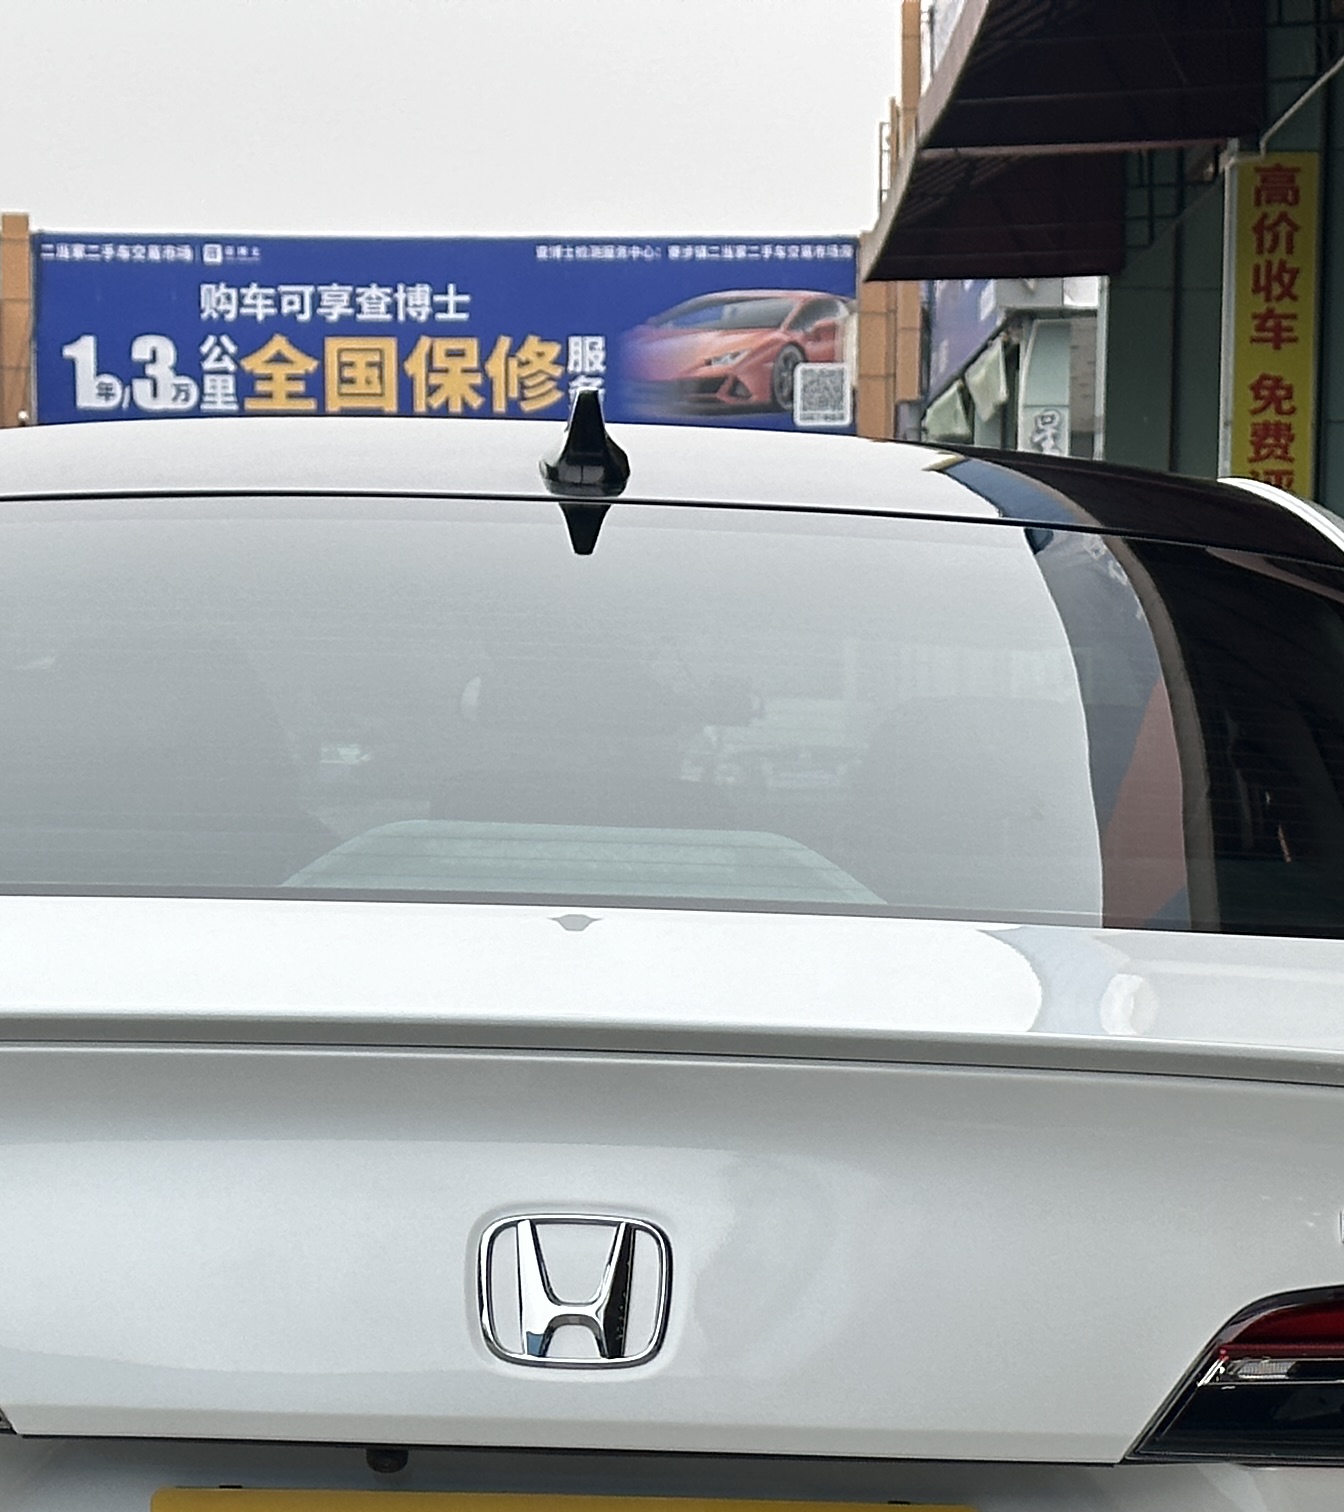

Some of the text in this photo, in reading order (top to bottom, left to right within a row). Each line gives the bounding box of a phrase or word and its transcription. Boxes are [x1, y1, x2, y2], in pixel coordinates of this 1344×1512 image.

[200, 283, 471, 321] 购车可享查博士
[1249, 162, 1301, 351] 高价收车
